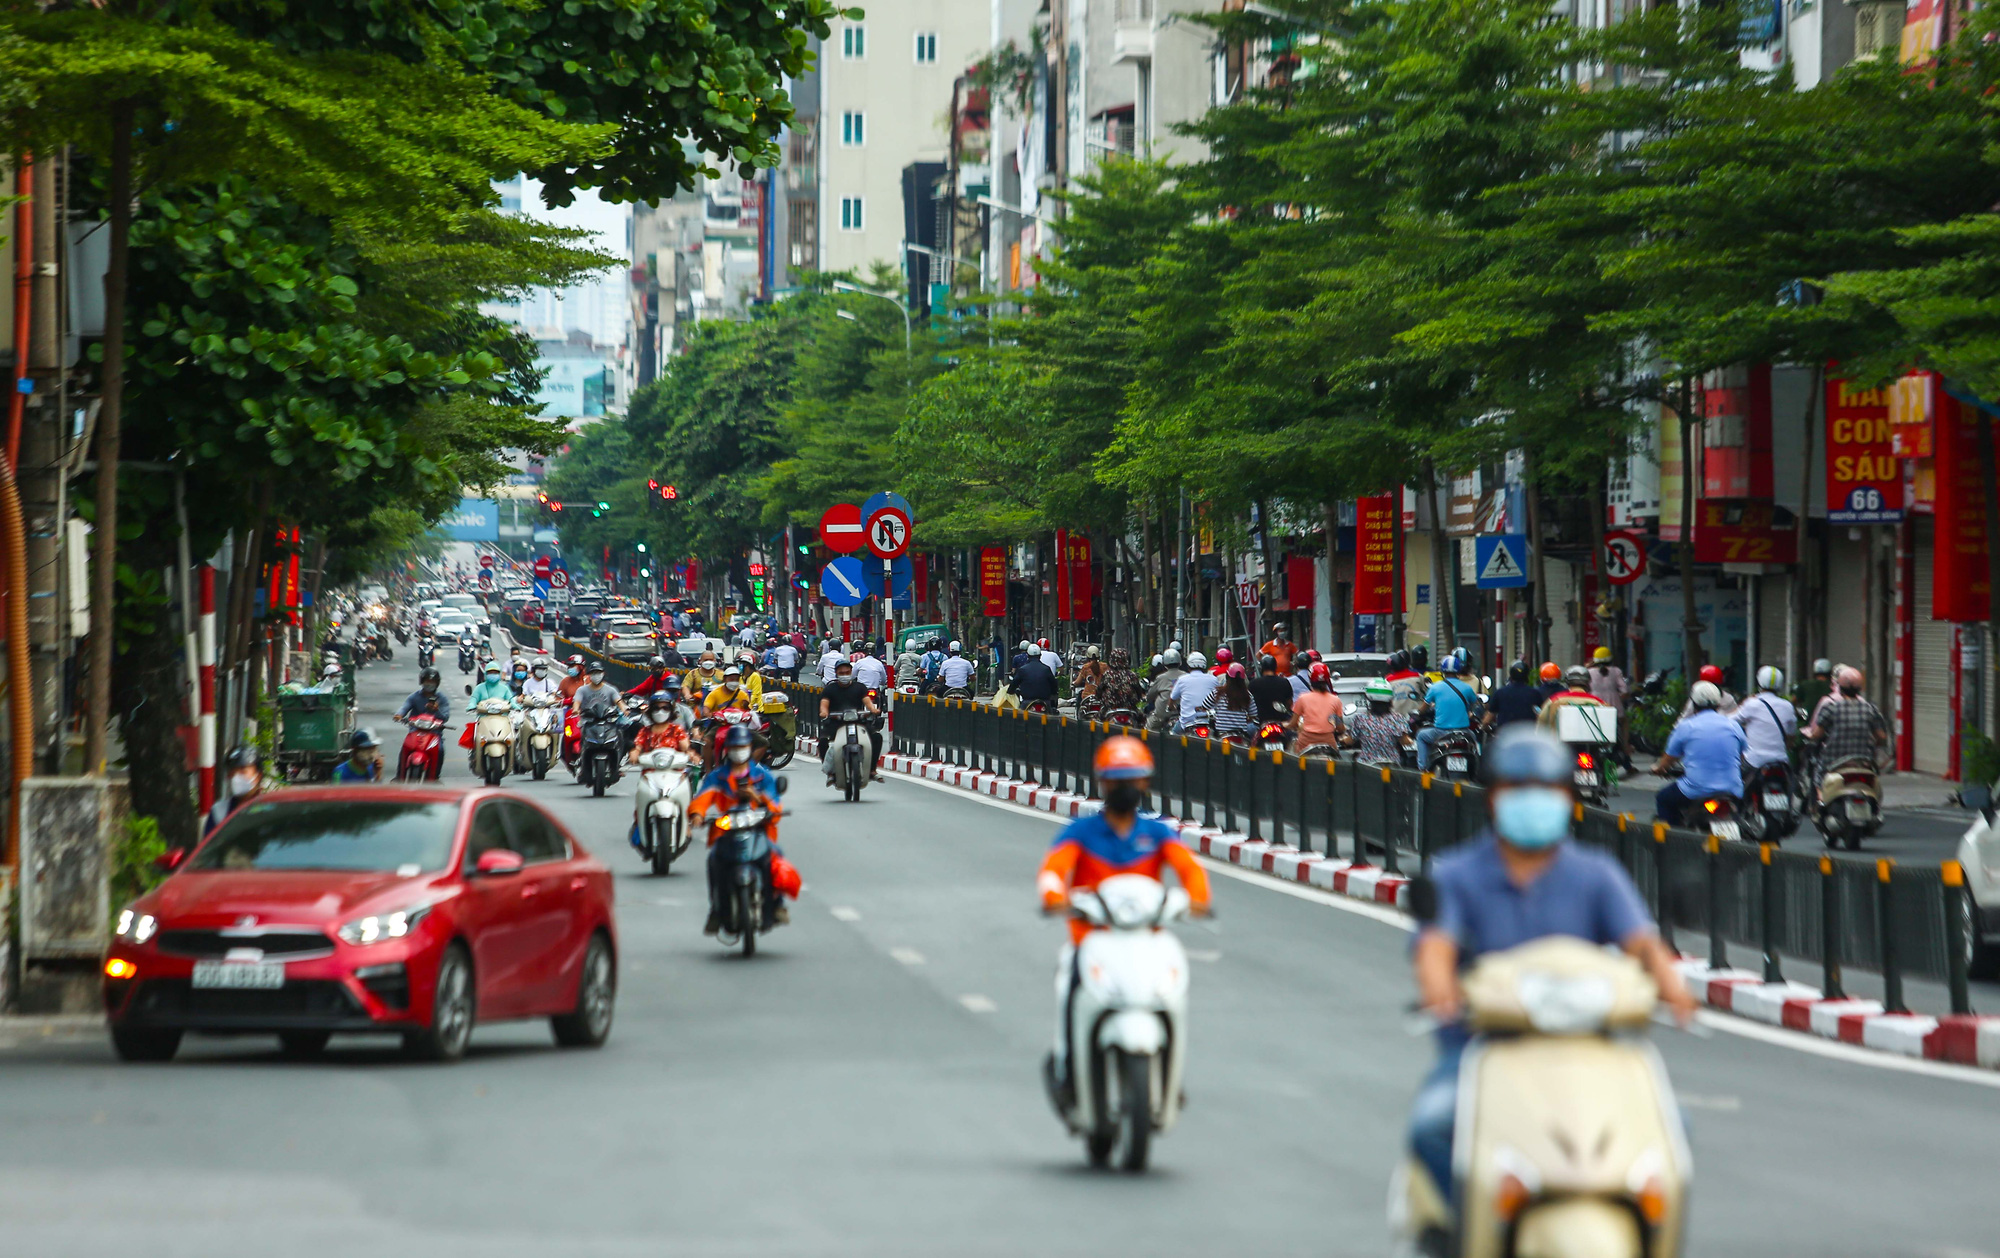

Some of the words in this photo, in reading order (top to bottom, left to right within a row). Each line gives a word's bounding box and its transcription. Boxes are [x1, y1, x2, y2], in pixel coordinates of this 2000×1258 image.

[1834, 450, 1897, 482] SÁU
[661, 485, 677, 500] 05
[1852, 489, 1879, 511] 66
[1721, 536, 1774, 560] 72
